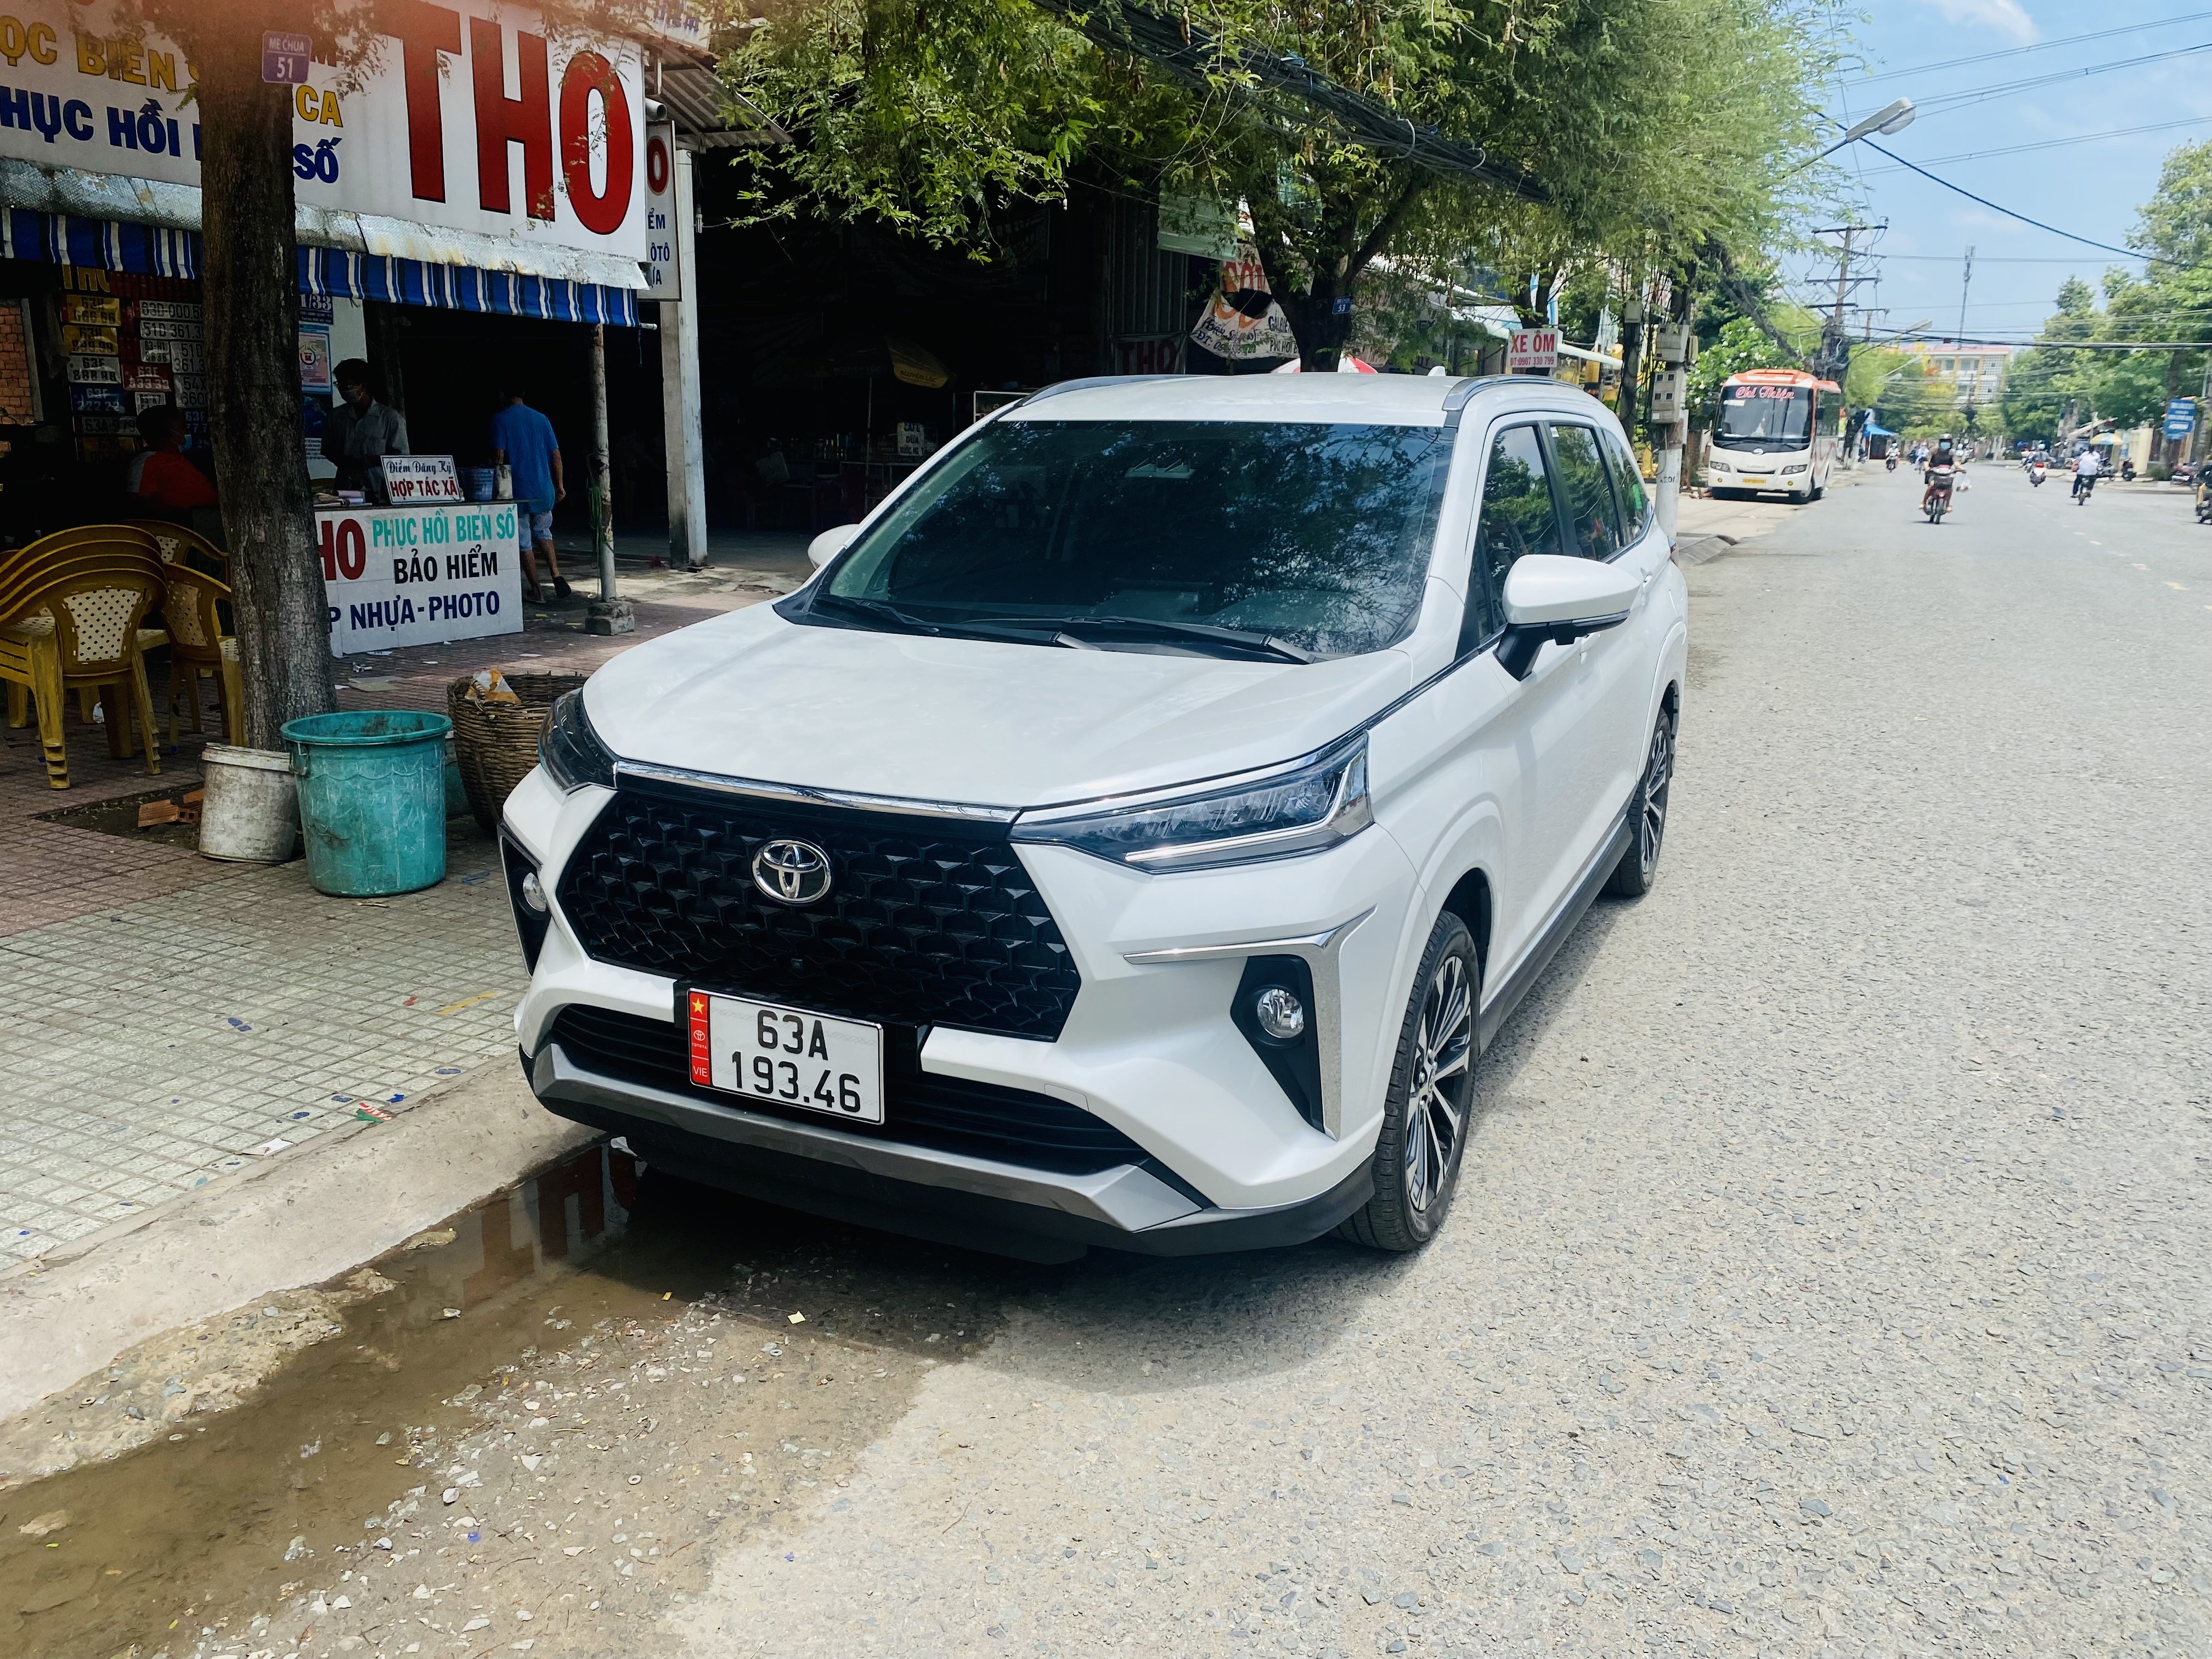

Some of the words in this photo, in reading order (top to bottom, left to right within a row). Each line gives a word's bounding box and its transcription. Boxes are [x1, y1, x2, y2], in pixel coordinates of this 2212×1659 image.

[276, 57, 293, 78] 51
[0, 86, 94, 143] HỤC
[106, 98, 181, 157] HỒI
[296, 84, 343, 127] CA
[379, 0, 634, 235] THO
[292, 138, 342, 183] SỐ
[1510, 334, 1528, 353] XE
[1533, 330, 1555, 353] ÔM
[1544, 356, 1554, 365] 799
[386, 460, 411, 473] Điểm
[412, 461, 436, 475] Đăng
[438, 460, 451, 475] Ký
[390, 478, 414, 500] HỢP
[416, 476, 440, 496] TÁC
[441, 476, 458, 495] XÃ
[372, 518, 417, 550] PHỤC
[422, 507, 449, 544] HỒI
[496, 504, 516, 540] SỐ
[394, 549, 438, 584] BẢO
[446, 544, 498, 580] HIỂM
[757, 1009, 829, 1061] 63A
[692, 1065, 708, 1077] VIE
[731, 1051, 861, 1113] 193.46
